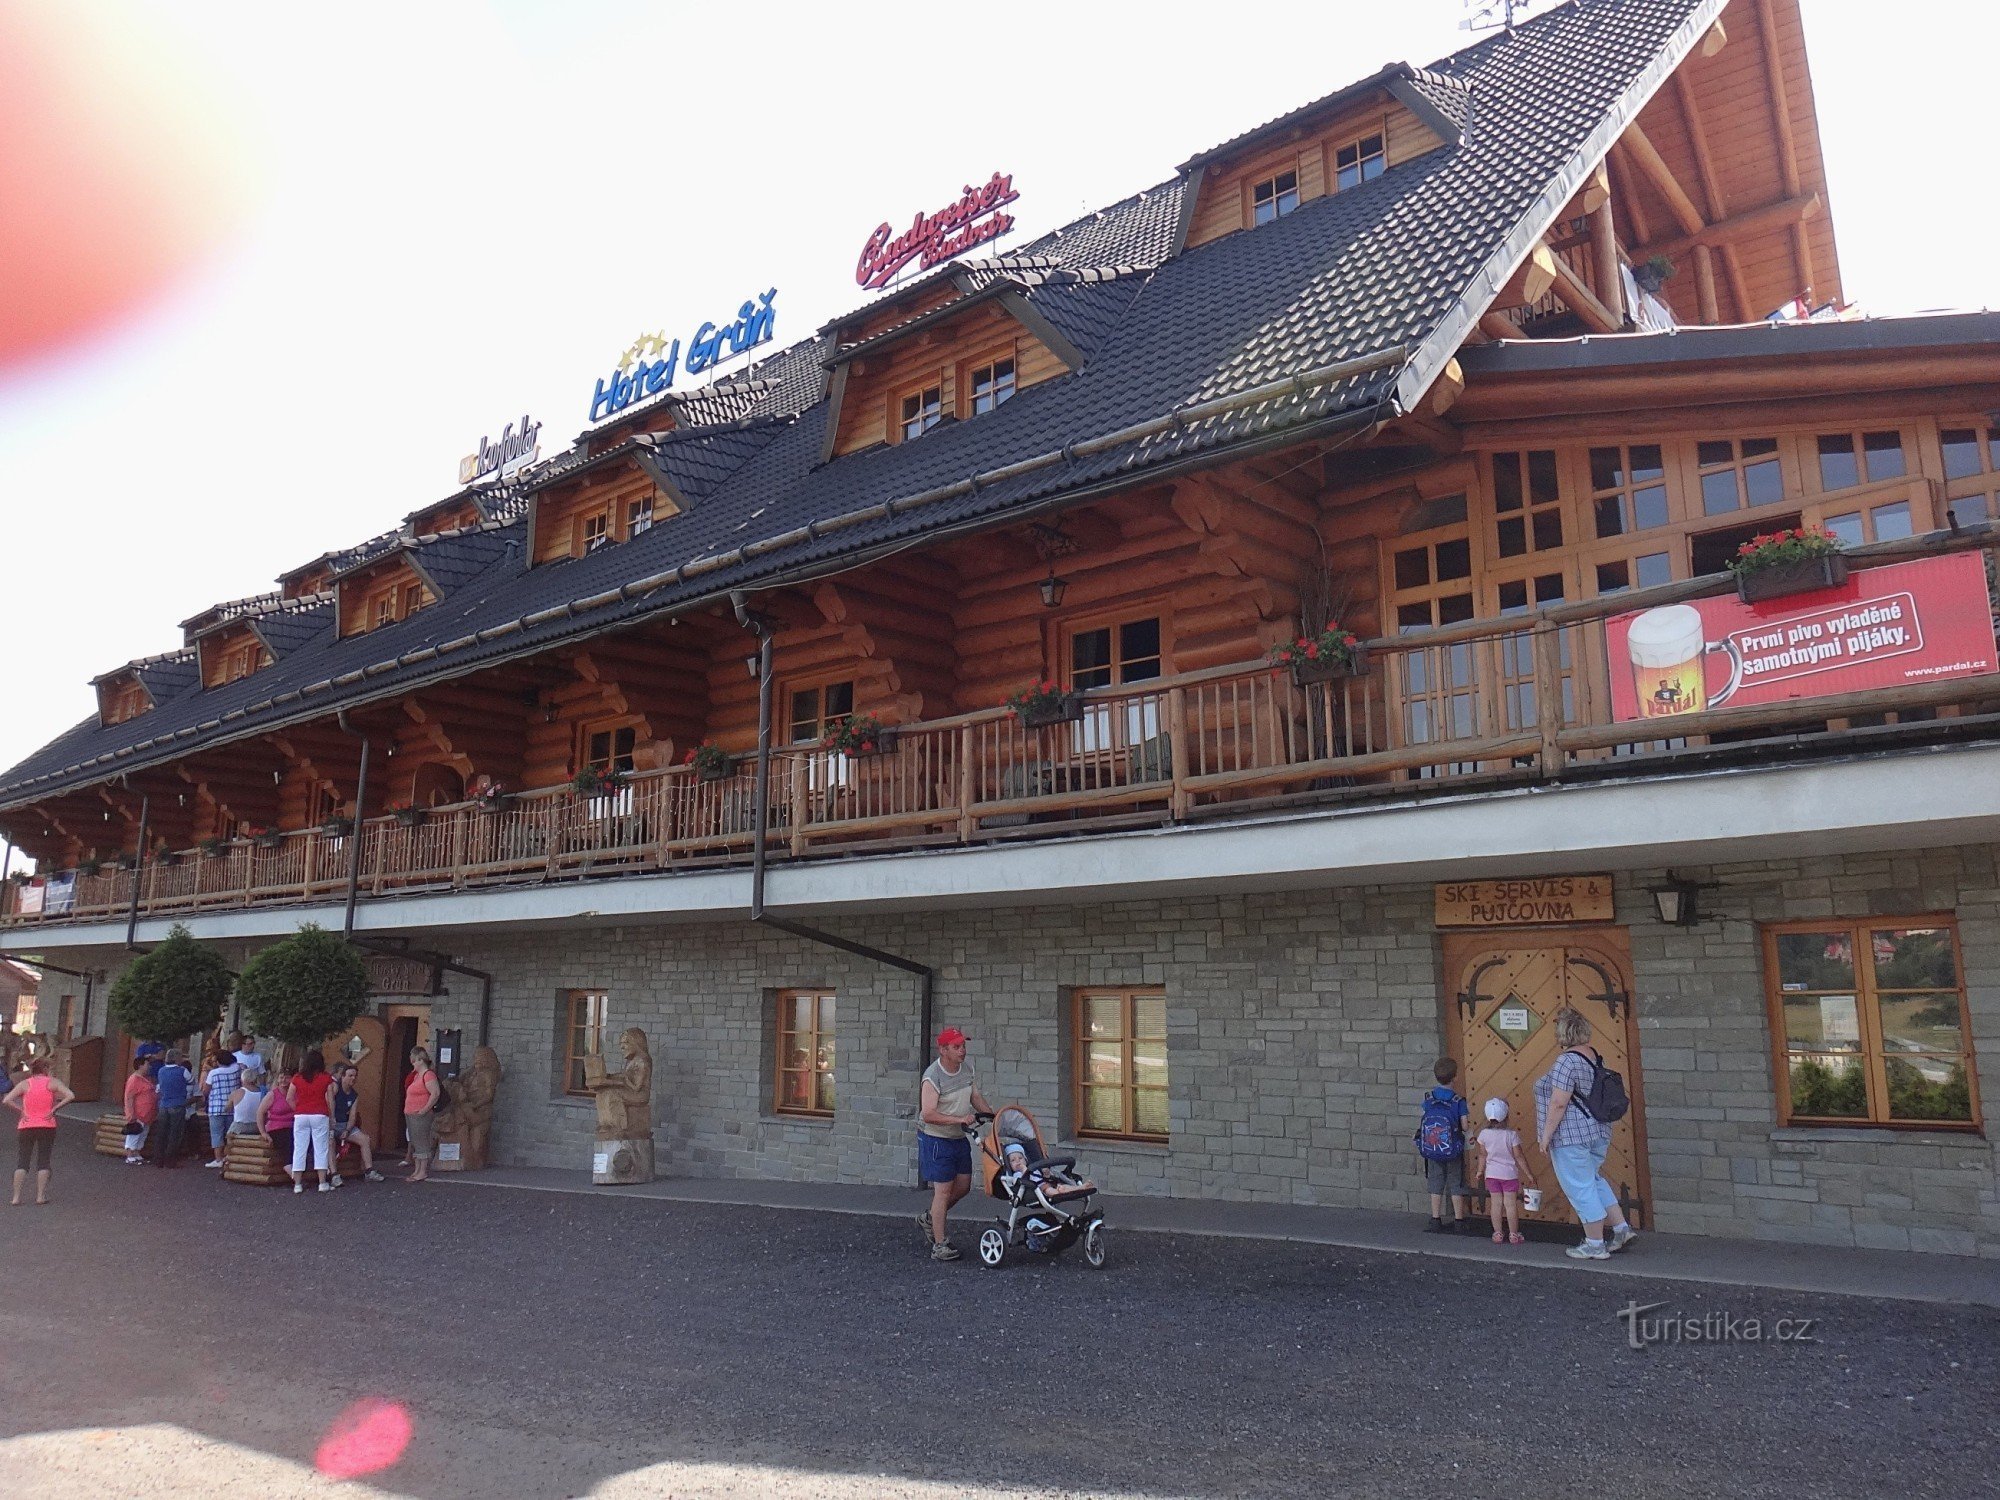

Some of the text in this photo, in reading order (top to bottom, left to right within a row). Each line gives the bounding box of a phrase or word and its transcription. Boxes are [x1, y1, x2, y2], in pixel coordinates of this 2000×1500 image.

[856, 172, 1020, 290] Budweiser
[919, 211, 1015, 270] Budvar
[589, 287, 777, 422] Hotel Grůň
[1741, 602, 1902, 653] První pivo vyladěné
[1742, 625, 1911, 676] samotnými pijáky.
[1904, 660, 1987, 678] www.pardal.cz
[1444, 879, 1600, 903] SKI SERVIS &
